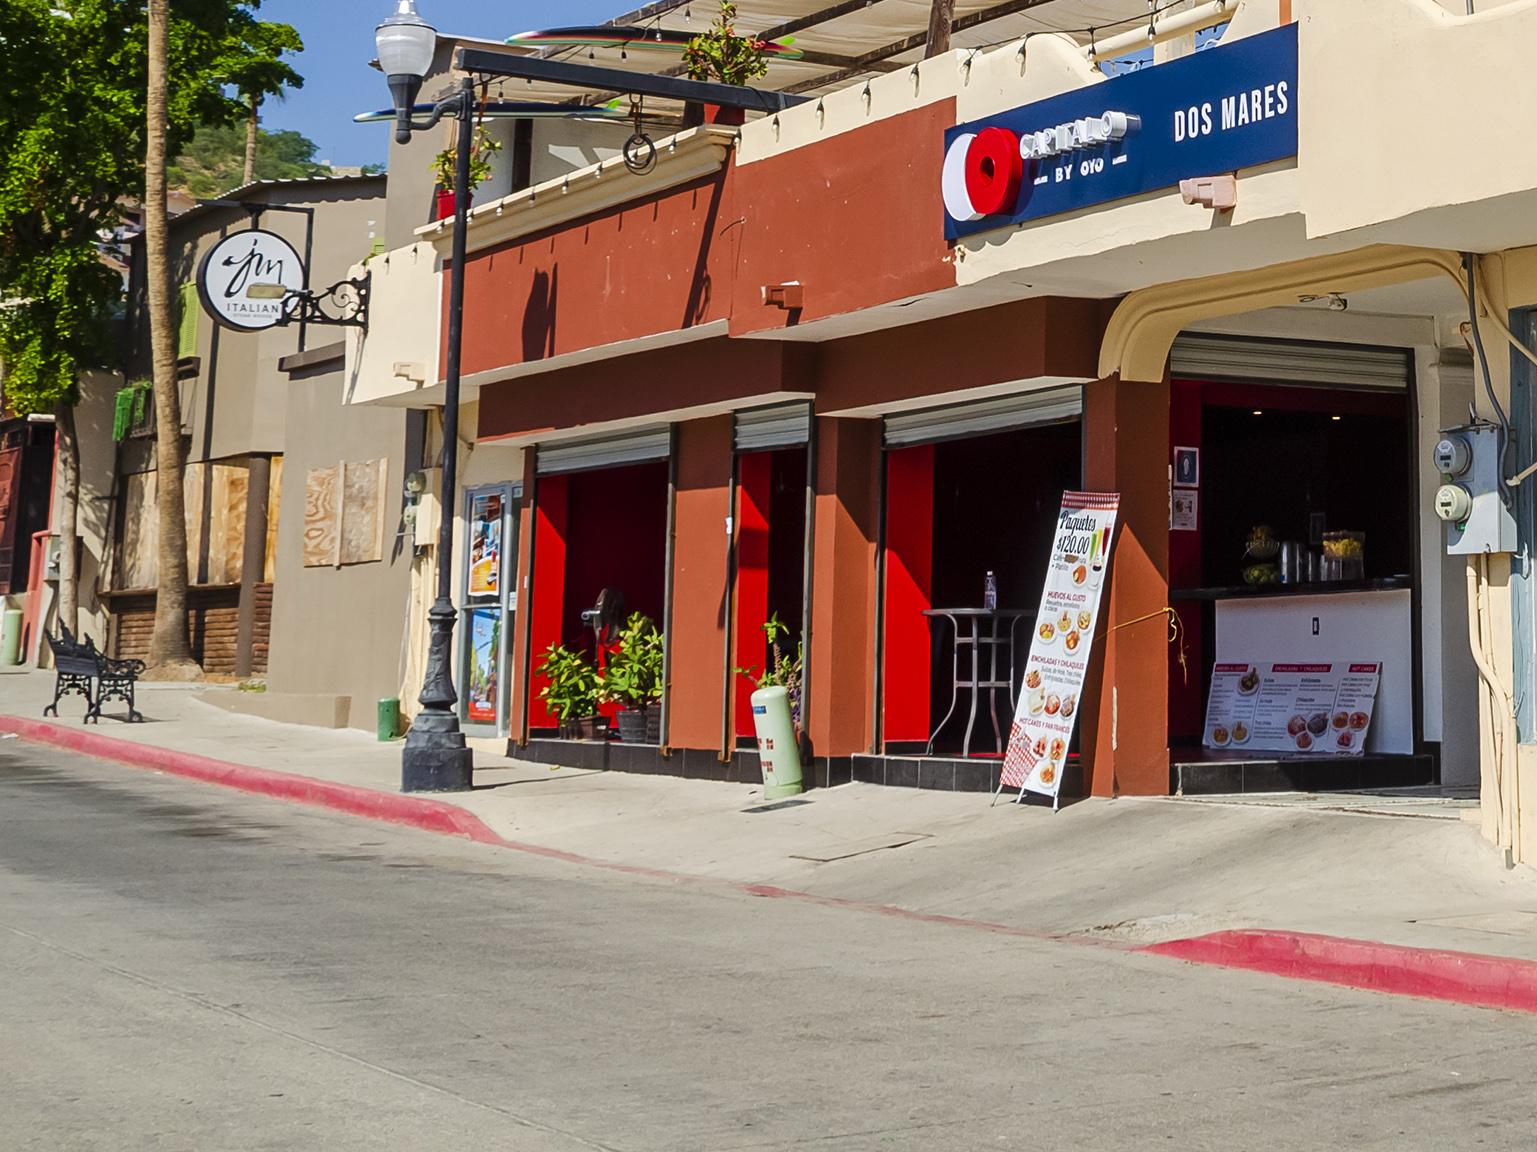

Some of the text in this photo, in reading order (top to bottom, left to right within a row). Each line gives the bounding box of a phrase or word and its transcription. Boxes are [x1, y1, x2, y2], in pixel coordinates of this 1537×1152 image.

[1174, 80, 1288, 143] DOS MARES
[1055, 157, 1105, 184] BY OYO
[226, 303, 279, 313] ITALIAN
[1060, 510, 1097, 535] Paquetes
[1056, 534, 1090, 555] $120.00
